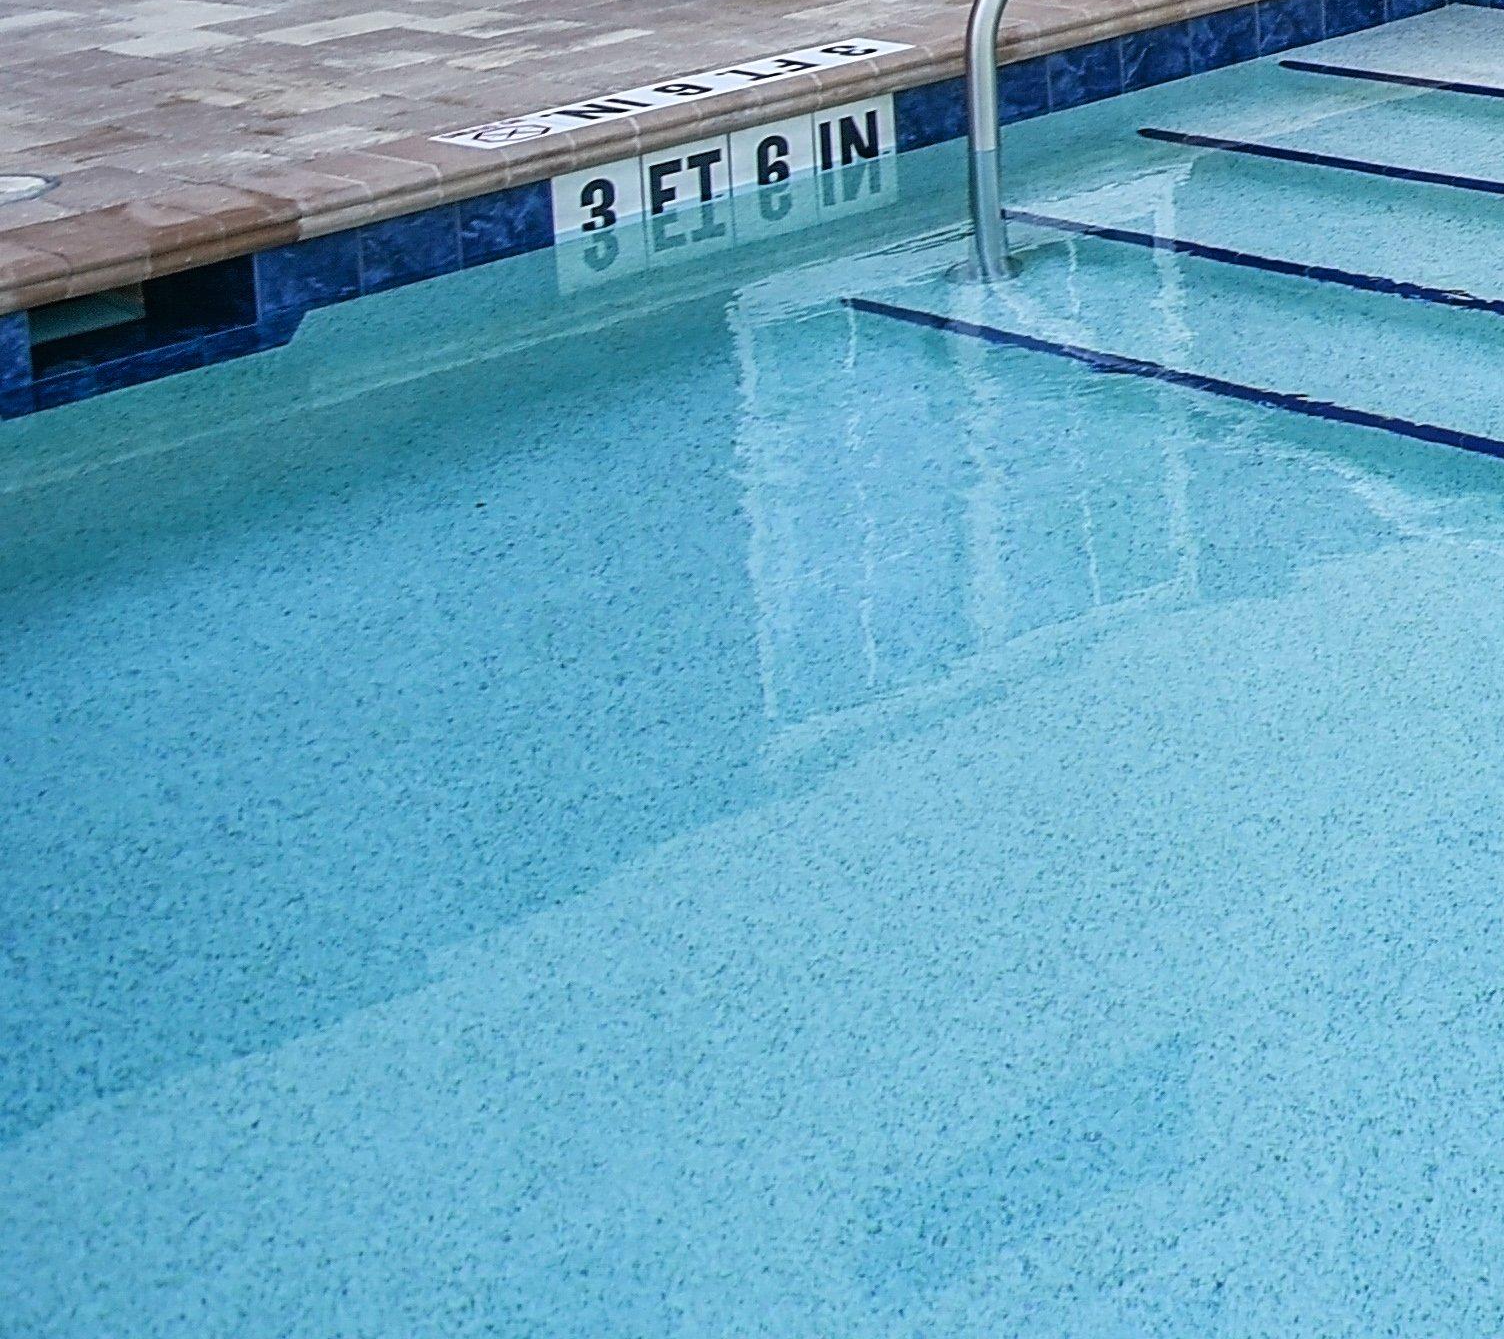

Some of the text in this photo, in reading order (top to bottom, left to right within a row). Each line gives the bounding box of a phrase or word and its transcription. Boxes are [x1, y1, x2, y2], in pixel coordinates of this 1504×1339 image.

[820, 44, 878, 57] 3
[653, 82, 713, 97] 6
[579, 178, 617, 232] 3
[757, 134, 790, 186] 6
